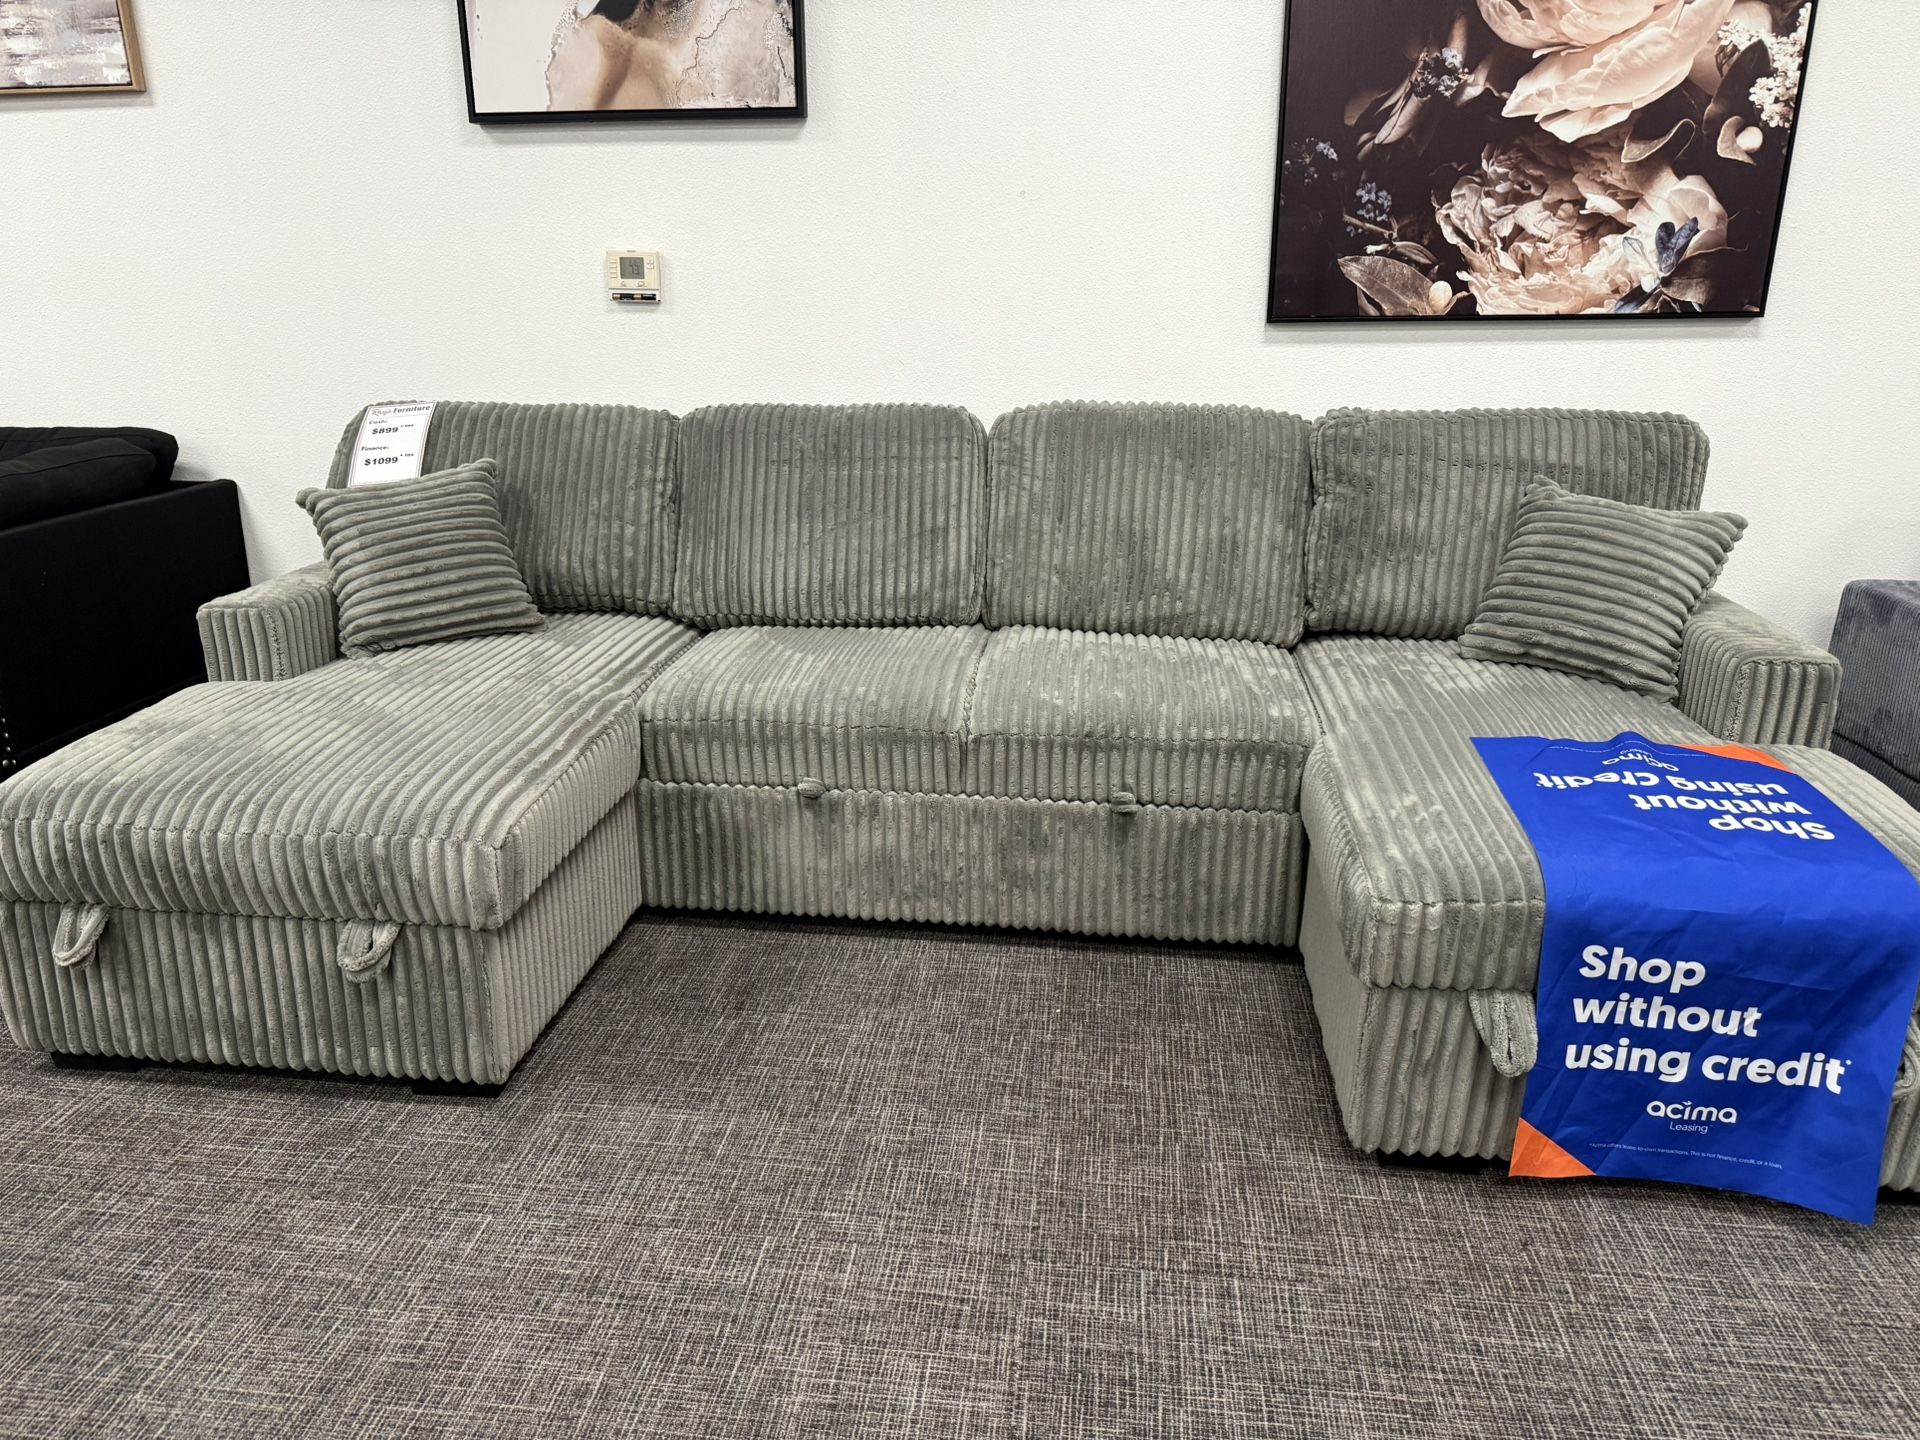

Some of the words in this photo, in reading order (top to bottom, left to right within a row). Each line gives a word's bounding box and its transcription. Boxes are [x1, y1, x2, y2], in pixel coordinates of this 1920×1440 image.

[393, 406, 431, 414] Furniture
[372, 426, 399, 435] $899
[364, 456, 399, 466] $1099
[1602, 753, 1679, 771] acima
[1665, 775, 1789, 796] using
[1628, 793, 1812, 815] without
[1708, 814, 1836, 841] Shop
[1578, 944, 1706, 993] Shop
[1572, 992, 1762, 1037] without
[1565, 1037, 1691, 1083] using
[1646, 1100, 1738, 1124] acima
